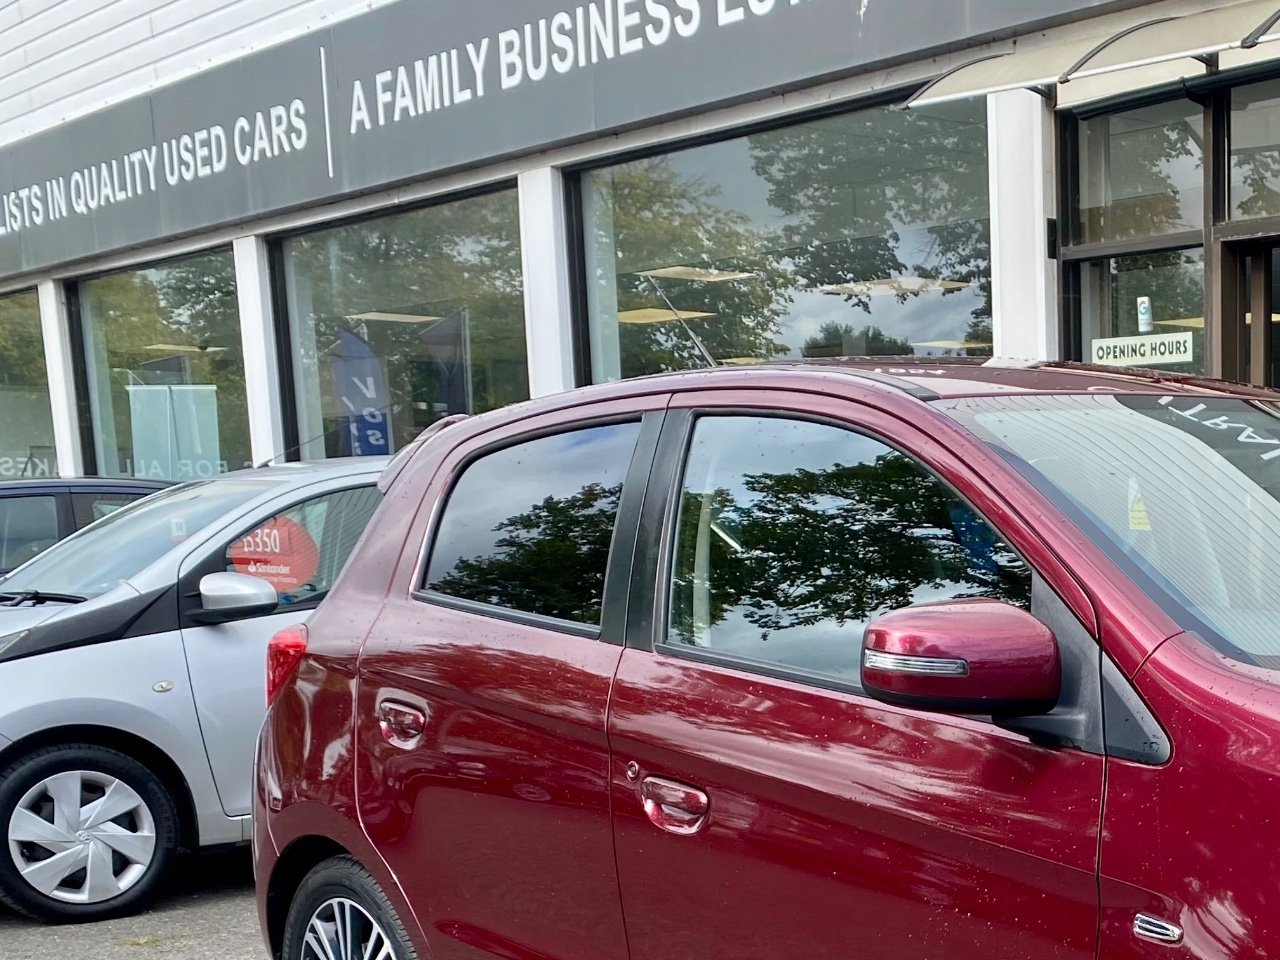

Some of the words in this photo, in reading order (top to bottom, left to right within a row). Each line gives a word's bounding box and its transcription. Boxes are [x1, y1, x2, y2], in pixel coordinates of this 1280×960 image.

[349, 80, 372, 133] A
[374, 37, 490, 126] FAMILY
[498, 0, 702, 90] BUSINESS
[46, 176, 67, 220] IN
[69, 145, 157, 215] QUALITY
[162, 124, 228, 187] USED
[233, 98, 308, 166] CARS
[1096, 343, 1146, 360] OPENING
[1150, 339, 1188, 356] HOURS
[255, 563, 290, 574] Santander
